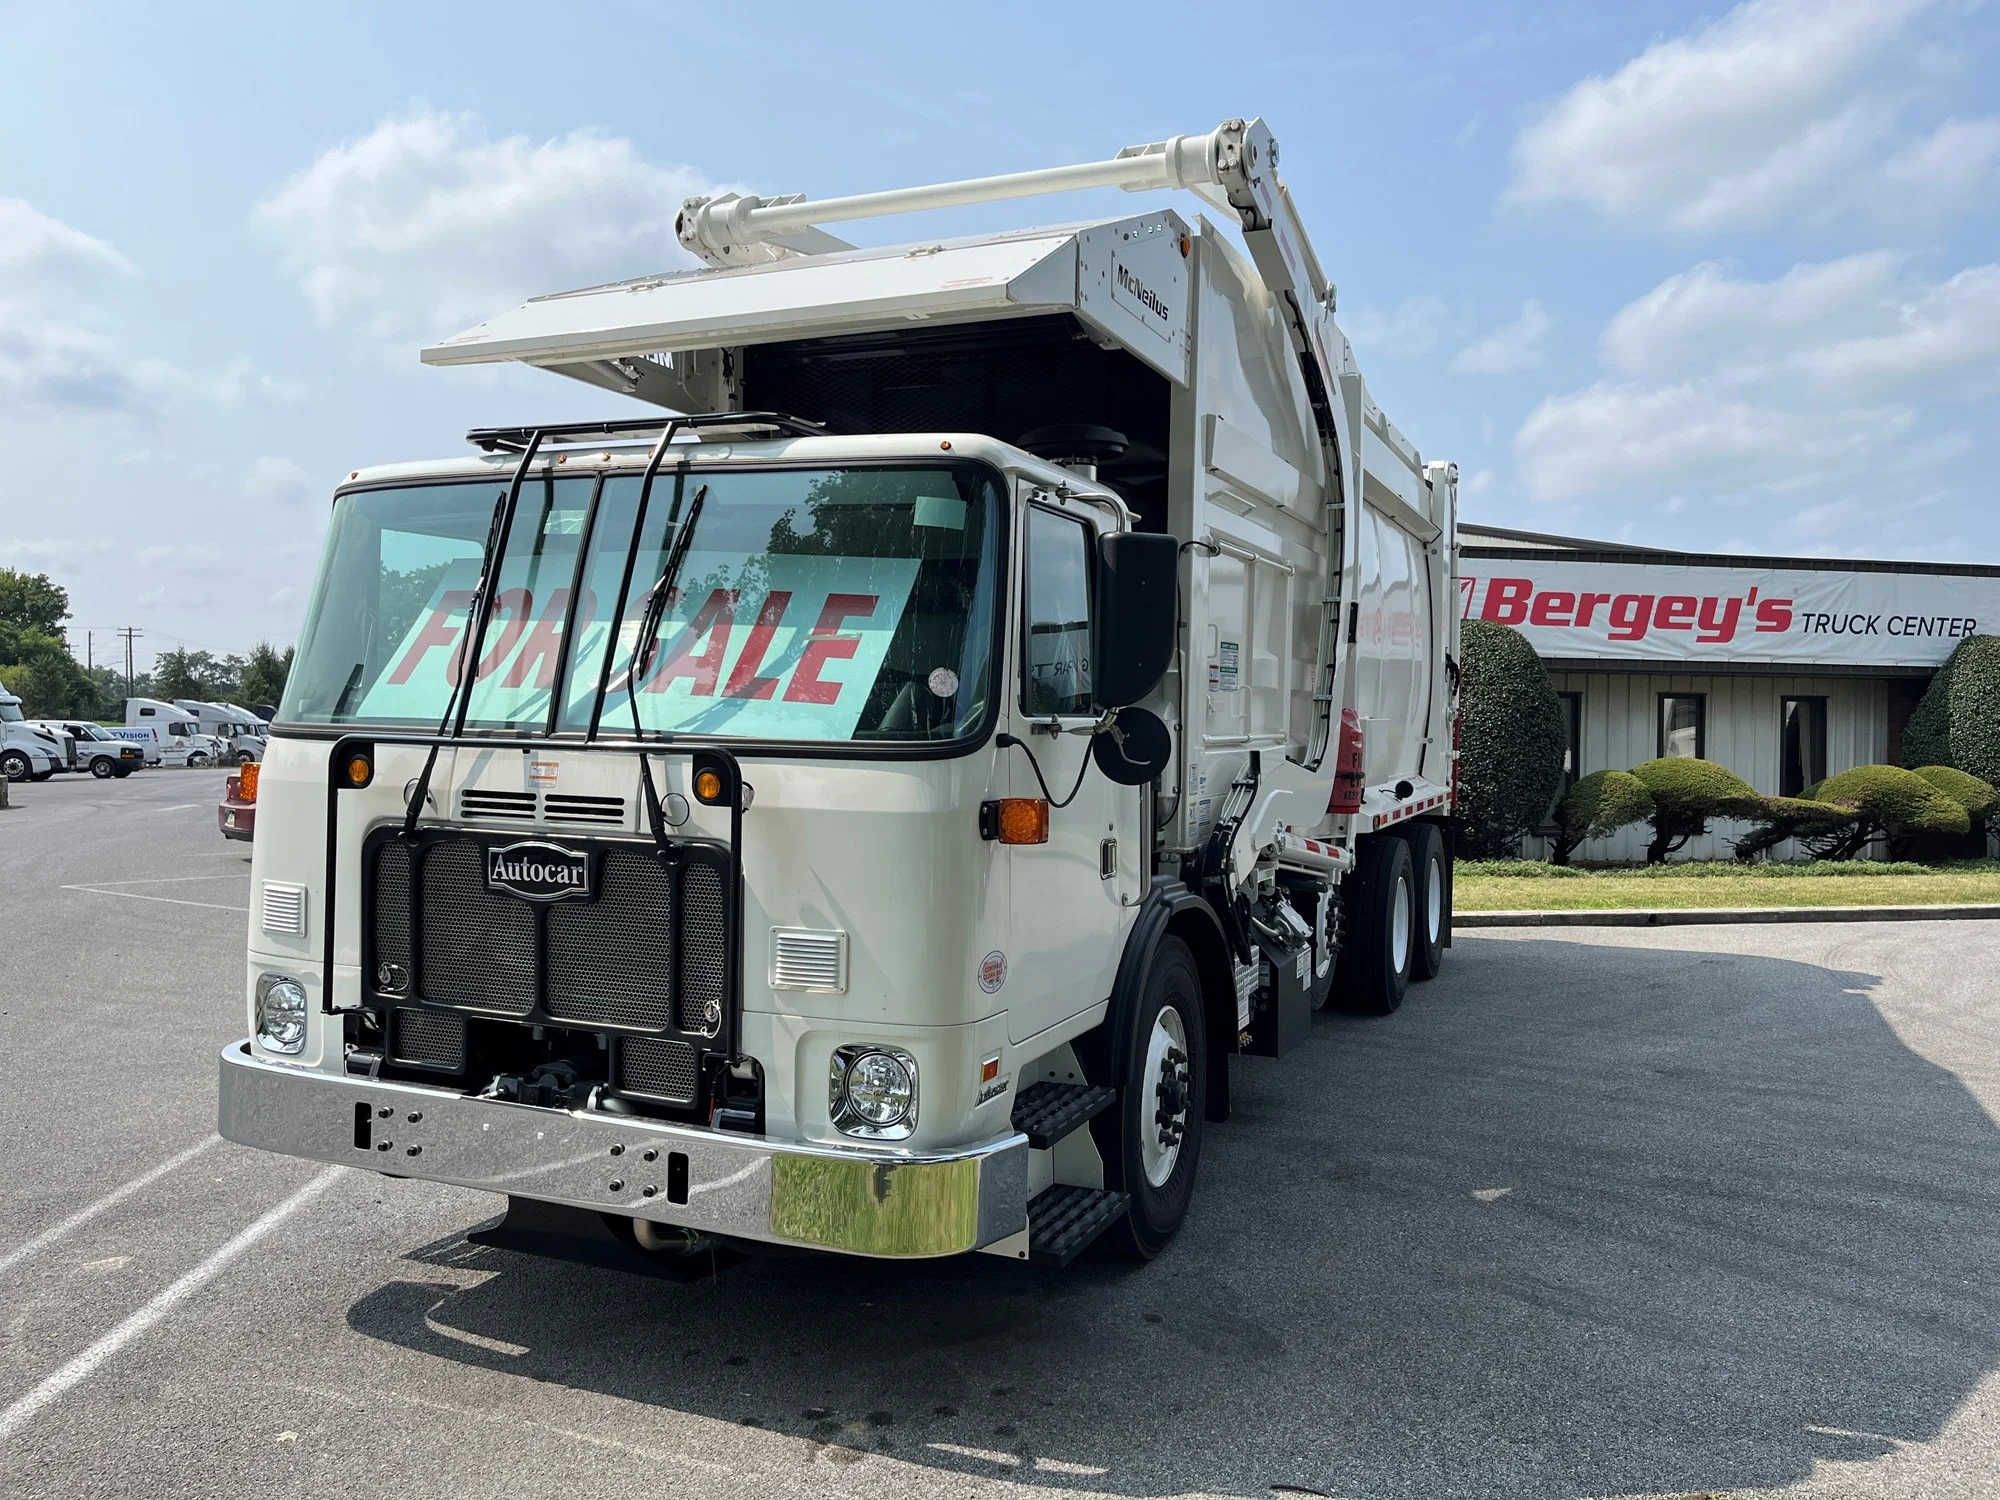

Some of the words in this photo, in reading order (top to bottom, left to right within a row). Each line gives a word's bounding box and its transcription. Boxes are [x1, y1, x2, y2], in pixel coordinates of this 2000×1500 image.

[1117, 263, 1169, 322] McNeilus
[386, 587, 599, 690] FOR
[1481, 578, 1793, 643] Bergey's
[1802, 613, 1881, 635] TRUCK
[1887, 616, 1977, 638] CENTER
[492, 854, 583, 884] Autocar
